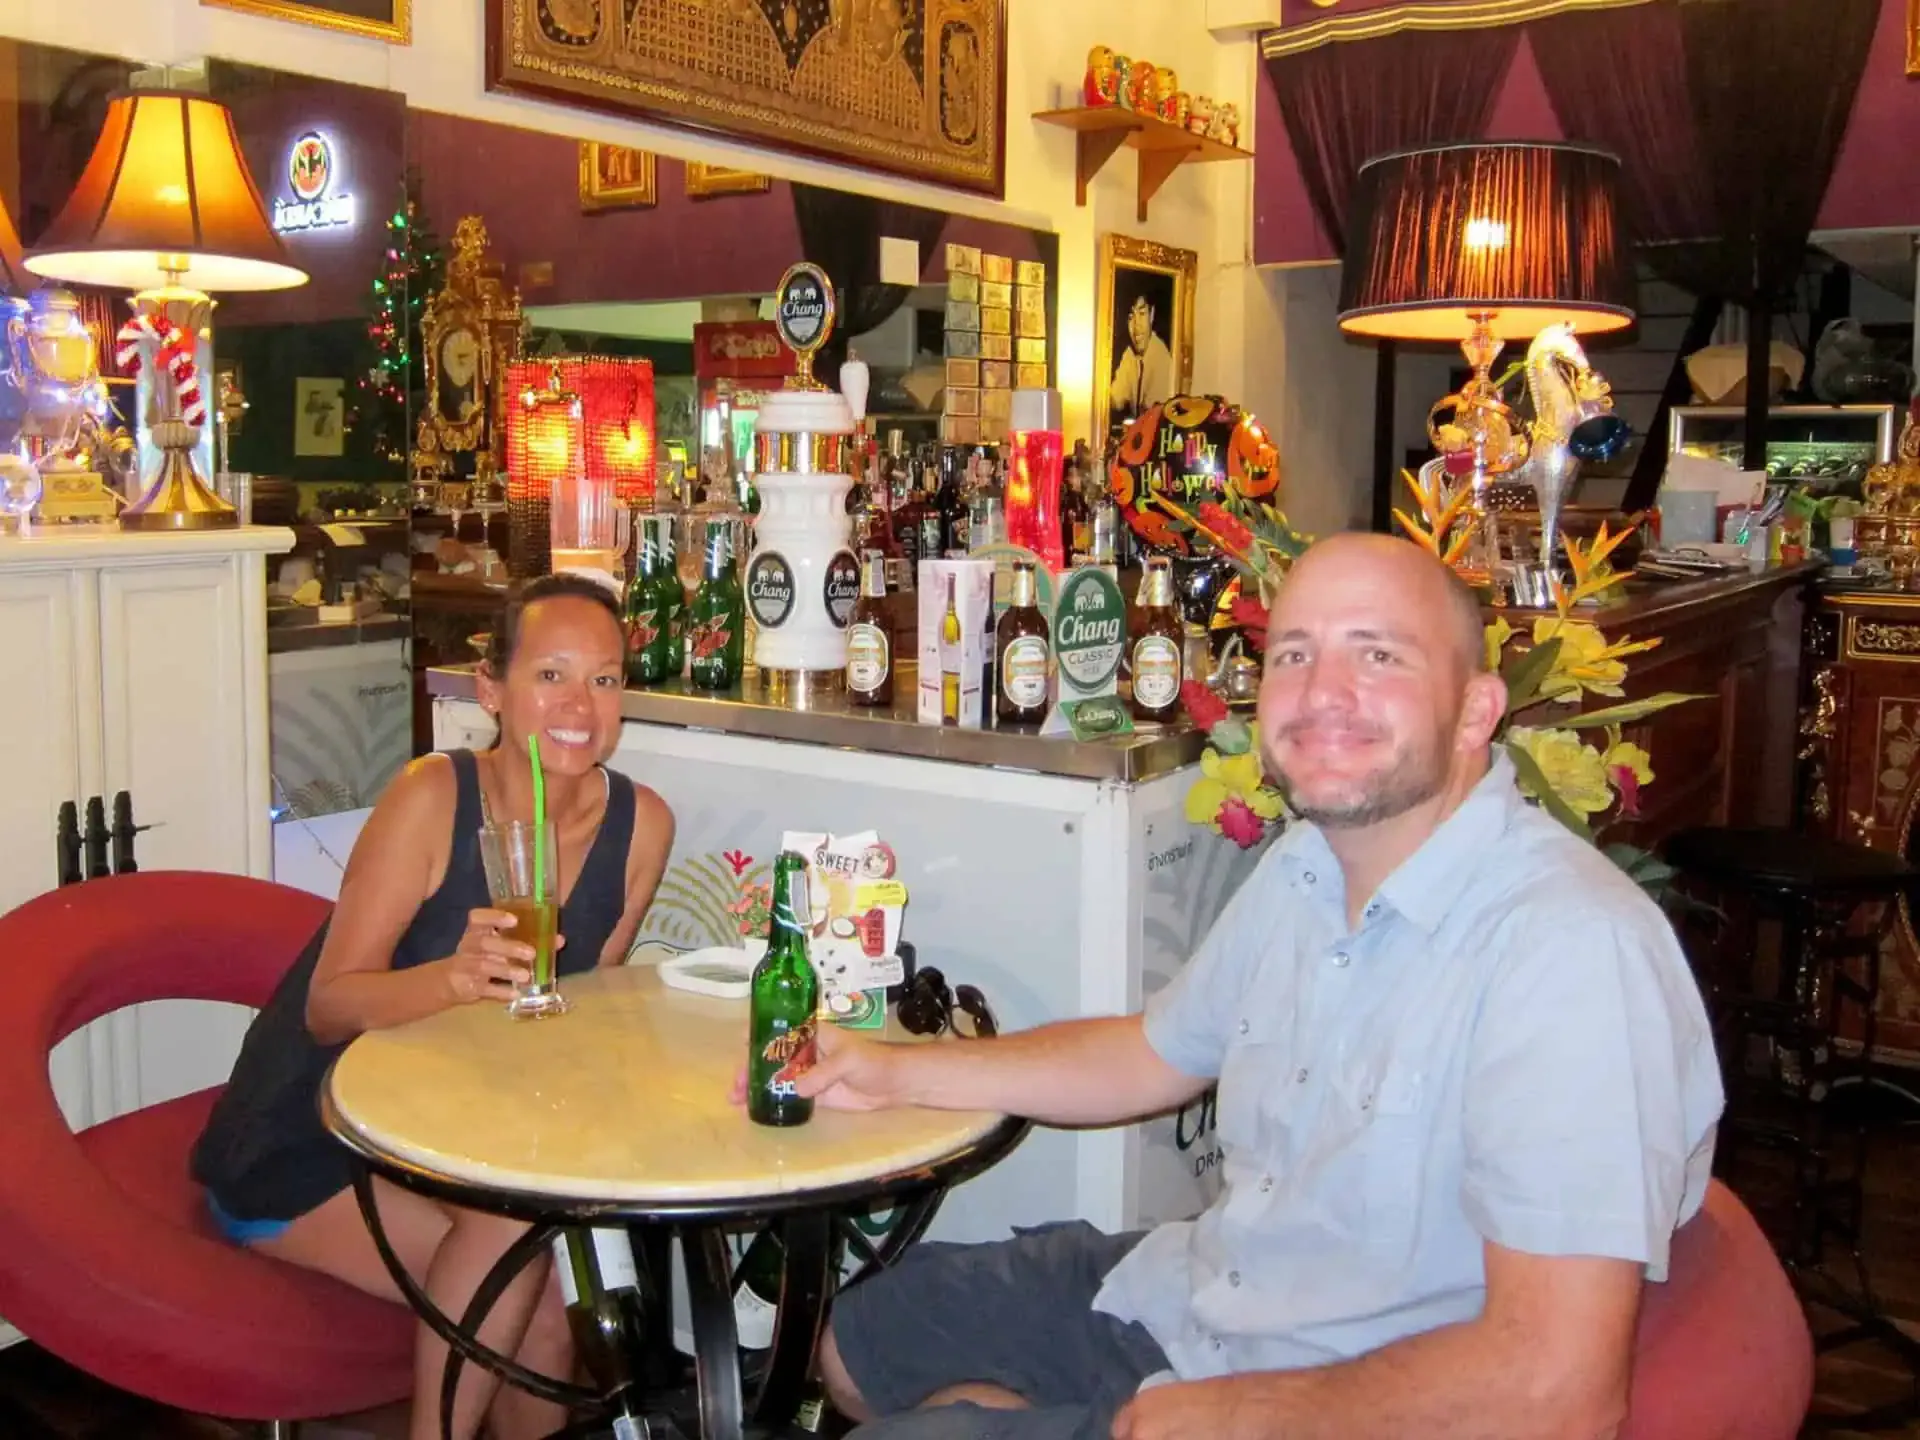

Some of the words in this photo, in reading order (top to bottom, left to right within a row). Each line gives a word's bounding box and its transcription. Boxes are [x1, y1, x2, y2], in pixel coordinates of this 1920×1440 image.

[783, 301, 823, 317] Chang
[751, 581, 791, 601] Chang
[828, 582, 859, 599] Chang
[1058, 614, 1120, 645] Chang
[1068, 648, 1113, 666] CLASSIC
[816, 850, 860, 873] SWEET
